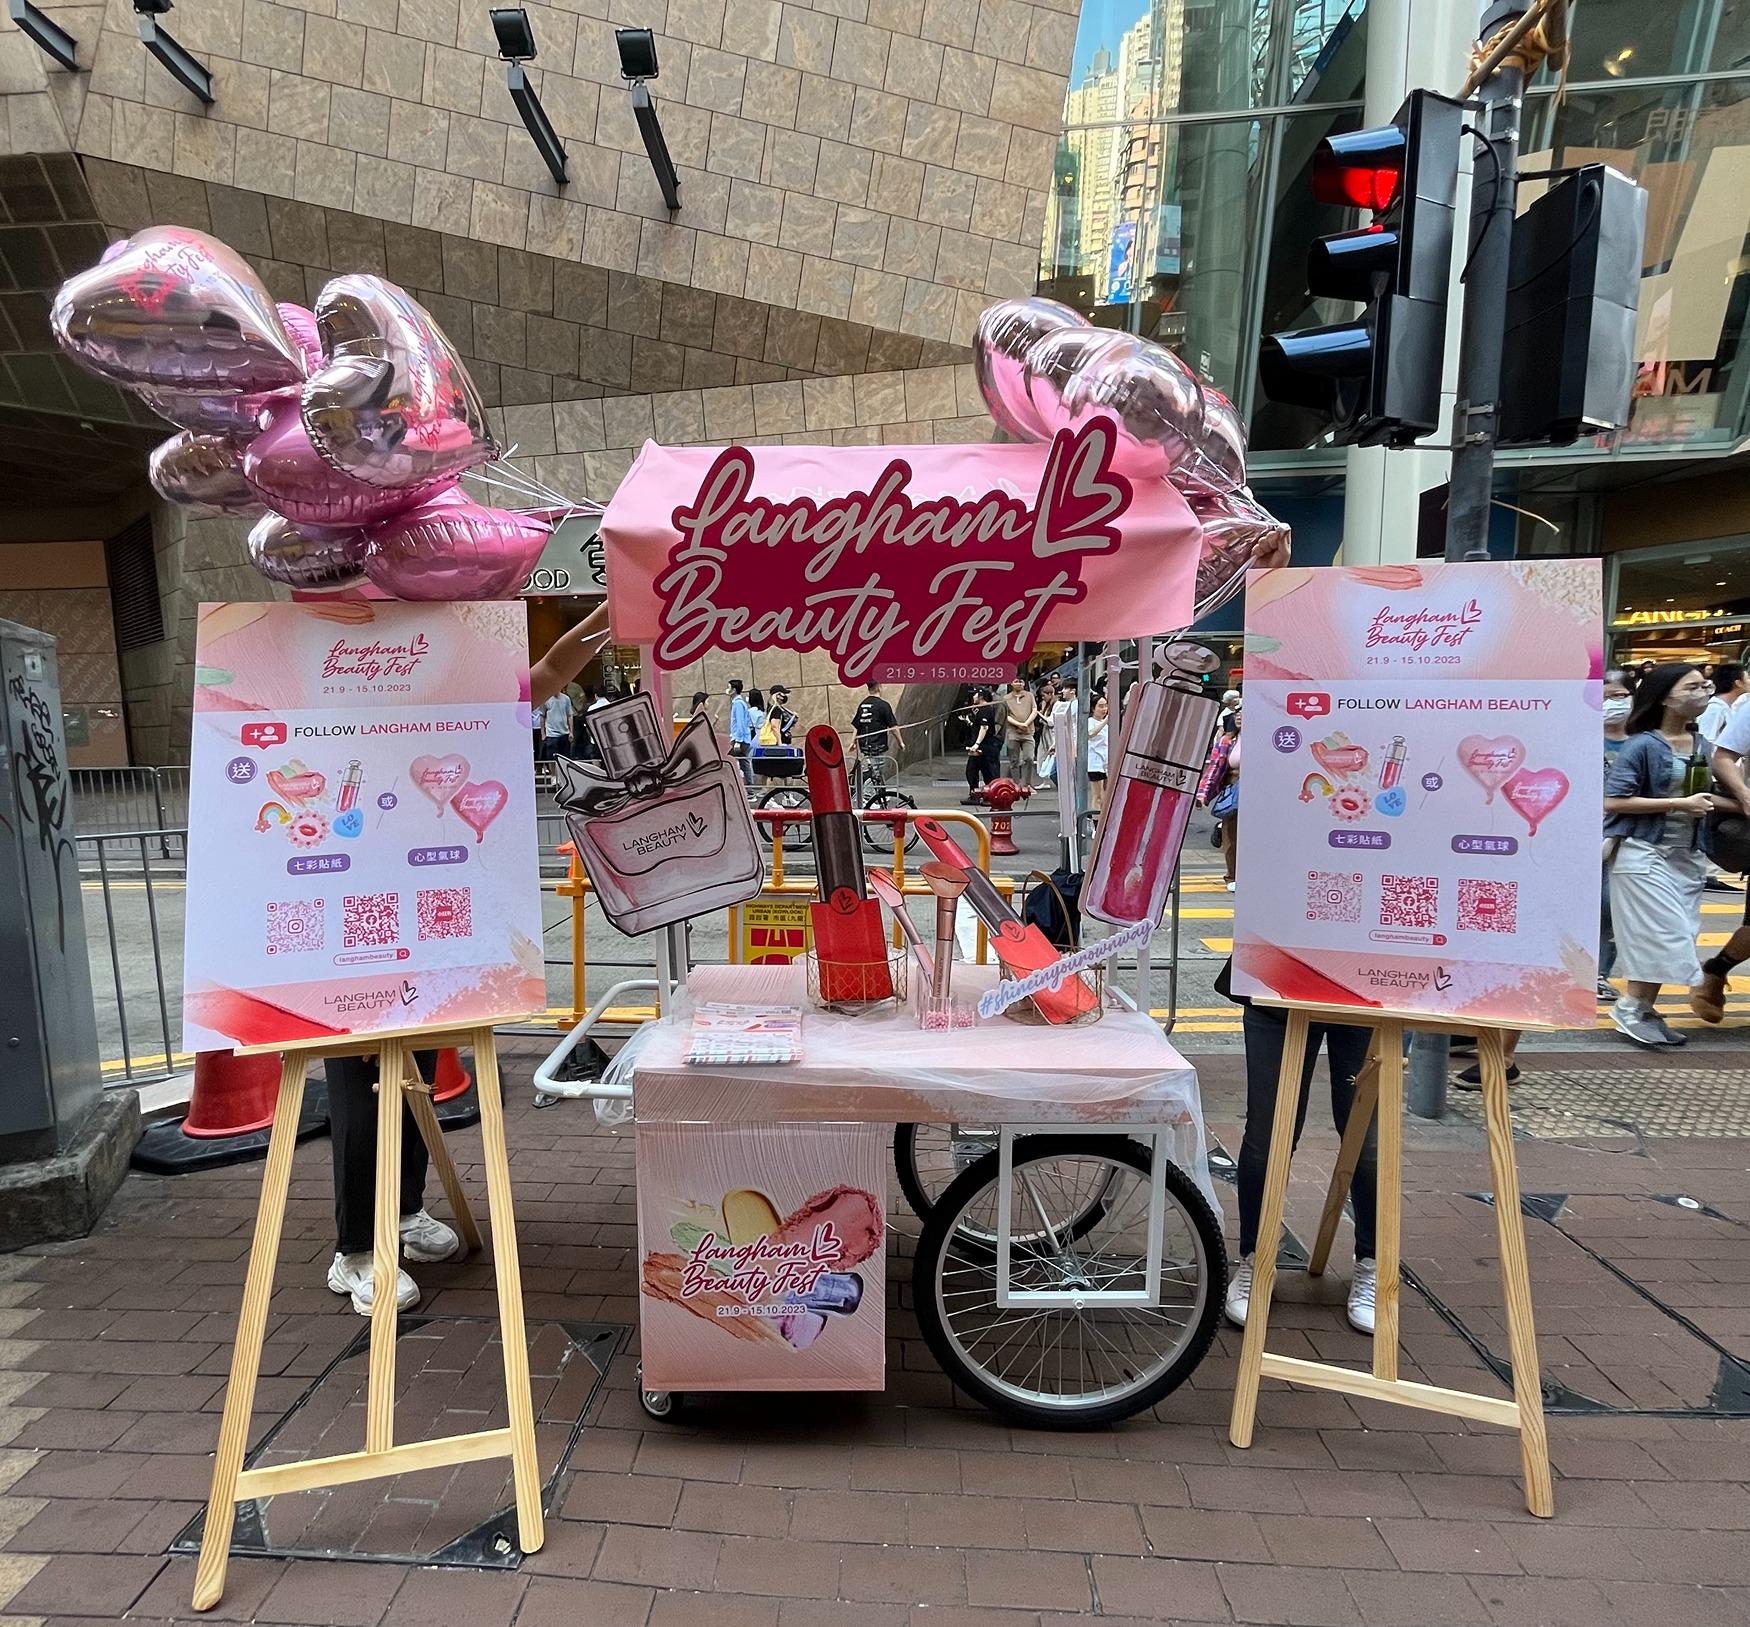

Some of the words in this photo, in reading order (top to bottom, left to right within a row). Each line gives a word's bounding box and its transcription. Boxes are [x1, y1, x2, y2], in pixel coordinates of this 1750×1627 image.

[677, 458, 1034, 582] Langham
[660, 559, 909, 677] Beauty
[913, 561, 1081, 660] Fest
[1371, 606, 1459, 630] Langham
[1365, 625, 1431, 651] Beauty
[1431, 624, 1474, 647] Fest
[328, 639, 409, 662] Langham
[1367, 656, 1390, 664] 21.9
[1402, 656, 1461, 664] 15.10.2023
[321, 658, 383, 681] Beauty
[384, 656, 422, 676] Fest
[886, 667, 915, 679] 21.9
[930, 667, 1004, 679] 15.10.2023
[357, 684, 411, 693] 15.10.2023
[1338, 698, 1400, 710] FOLLOW
[1405, 699, 1482, 710] LANGHAM
[1488, 700, 1551, 711] BEAUTY
[294, 725, 357, 739] FOLLOW
[360, 722, 431, 735] LANGHAM
[436, 720, 490, 733] BEAUTY
[1278, 731, 1297, 748] 送
[231, 761, 251, 779] 送
[1136, 763, 1176, 778] LANGHAM
[1141, 771, 1173, 783] BEAUTY
[622, 823, 687, 850] LANGHAM
[636, 832, 687, 855] BEAUTY
[1335, 834, 1384, 846] 七彩貼紙
[1458, 839, 1510, 851] 心型氣球
[414, 850, 461, 862] 心型氣球
[294, 857, 343, 871] 七彩貼紙
[1374, 932, 1430, 943] langhambeauty
[339, 952, 394, 963] langhambeauty
[980, 923, 1153, 1015] #shineinyourownway
[1358, 968, 1430, 981] LANGHAM
[1370, 977, 1428, 989] BEAUTY
[324, 990, 396, 1005] LANGHAM
[337, 998, 395, 1012] BEAUTY
[690, 1232, 811, 1270] Langham
[682, 1263, 771, 1301] Beauty
[772, 1262, 830, 1294] Fest
[718, 1307, 740, 1315] 21.9
[751, 1305, 806, 1315] 15.10.2023
